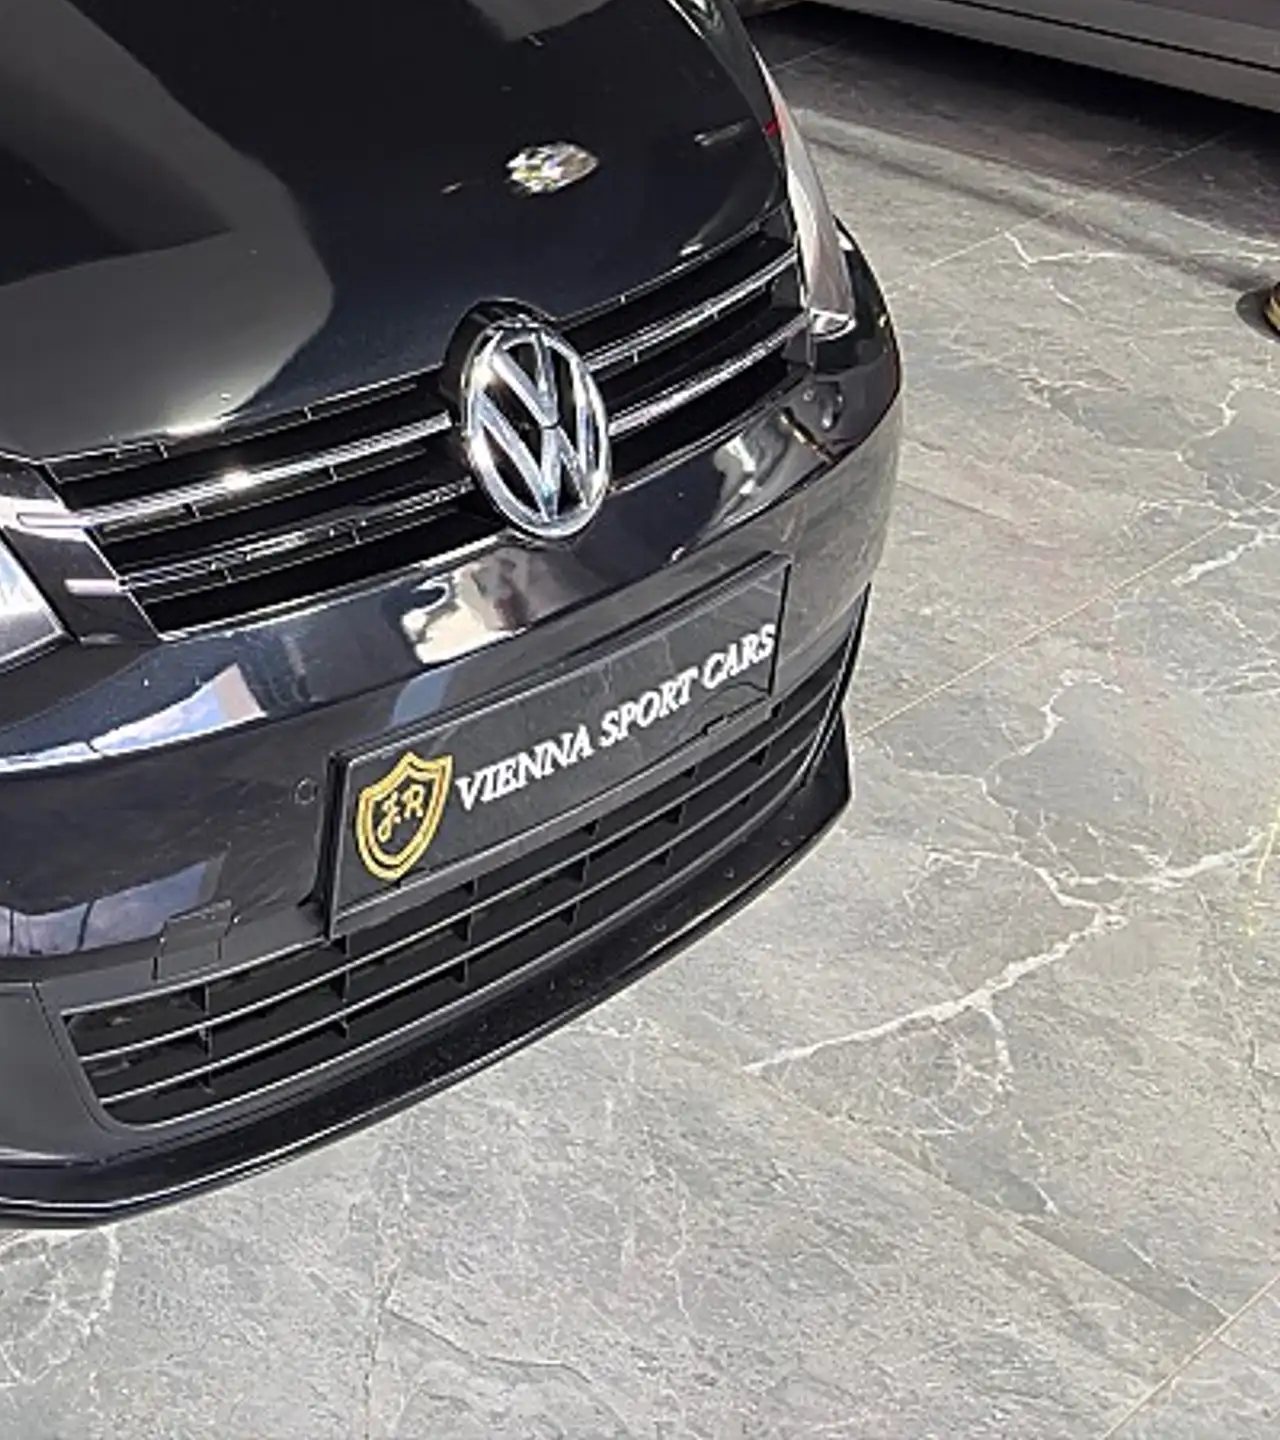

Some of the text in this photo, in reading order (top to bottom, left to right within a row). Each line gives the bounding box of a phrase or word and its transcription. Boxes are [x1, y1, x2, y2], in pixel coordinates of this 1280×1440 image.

[454, 724, 594, 811] VIENNA
[600, 666, 699, 745] SPORT
[701, 623, 776, 689] CARS
